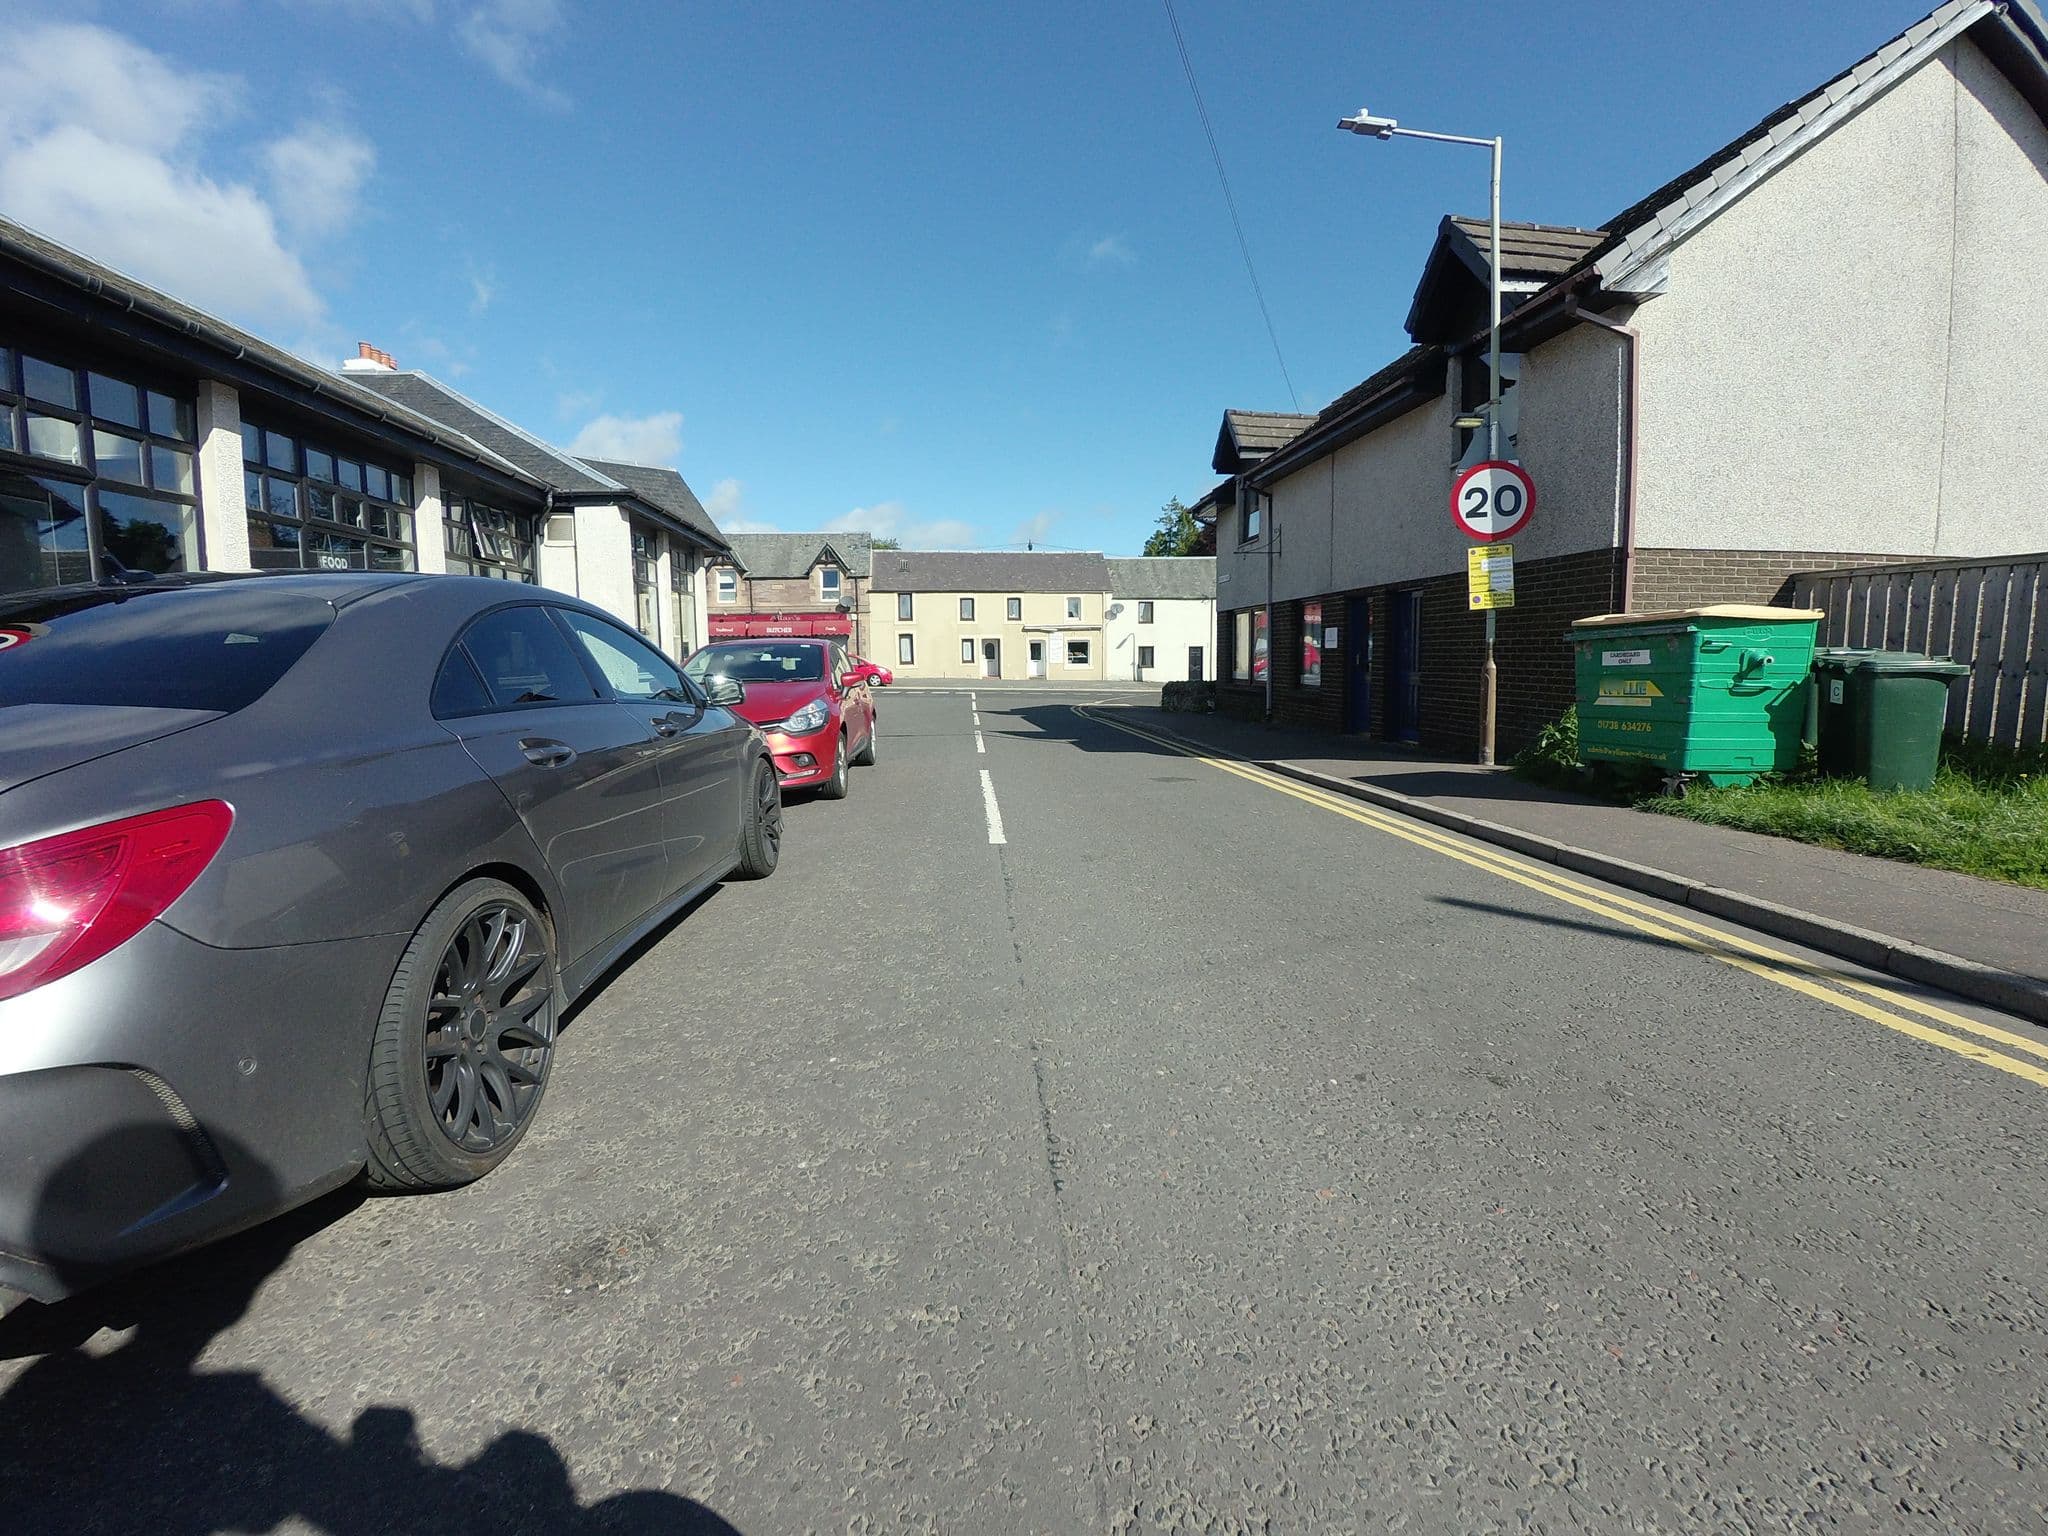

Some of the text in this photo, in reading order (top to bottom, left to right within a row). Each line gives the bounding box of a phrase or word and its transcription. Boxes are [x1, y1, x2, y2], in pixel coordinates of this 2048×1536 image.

[1464, 485, 1522, 518] 20
[320, 555, 348, 569] FOOD
[1598, 720, 1652, 732] 01738 634276
